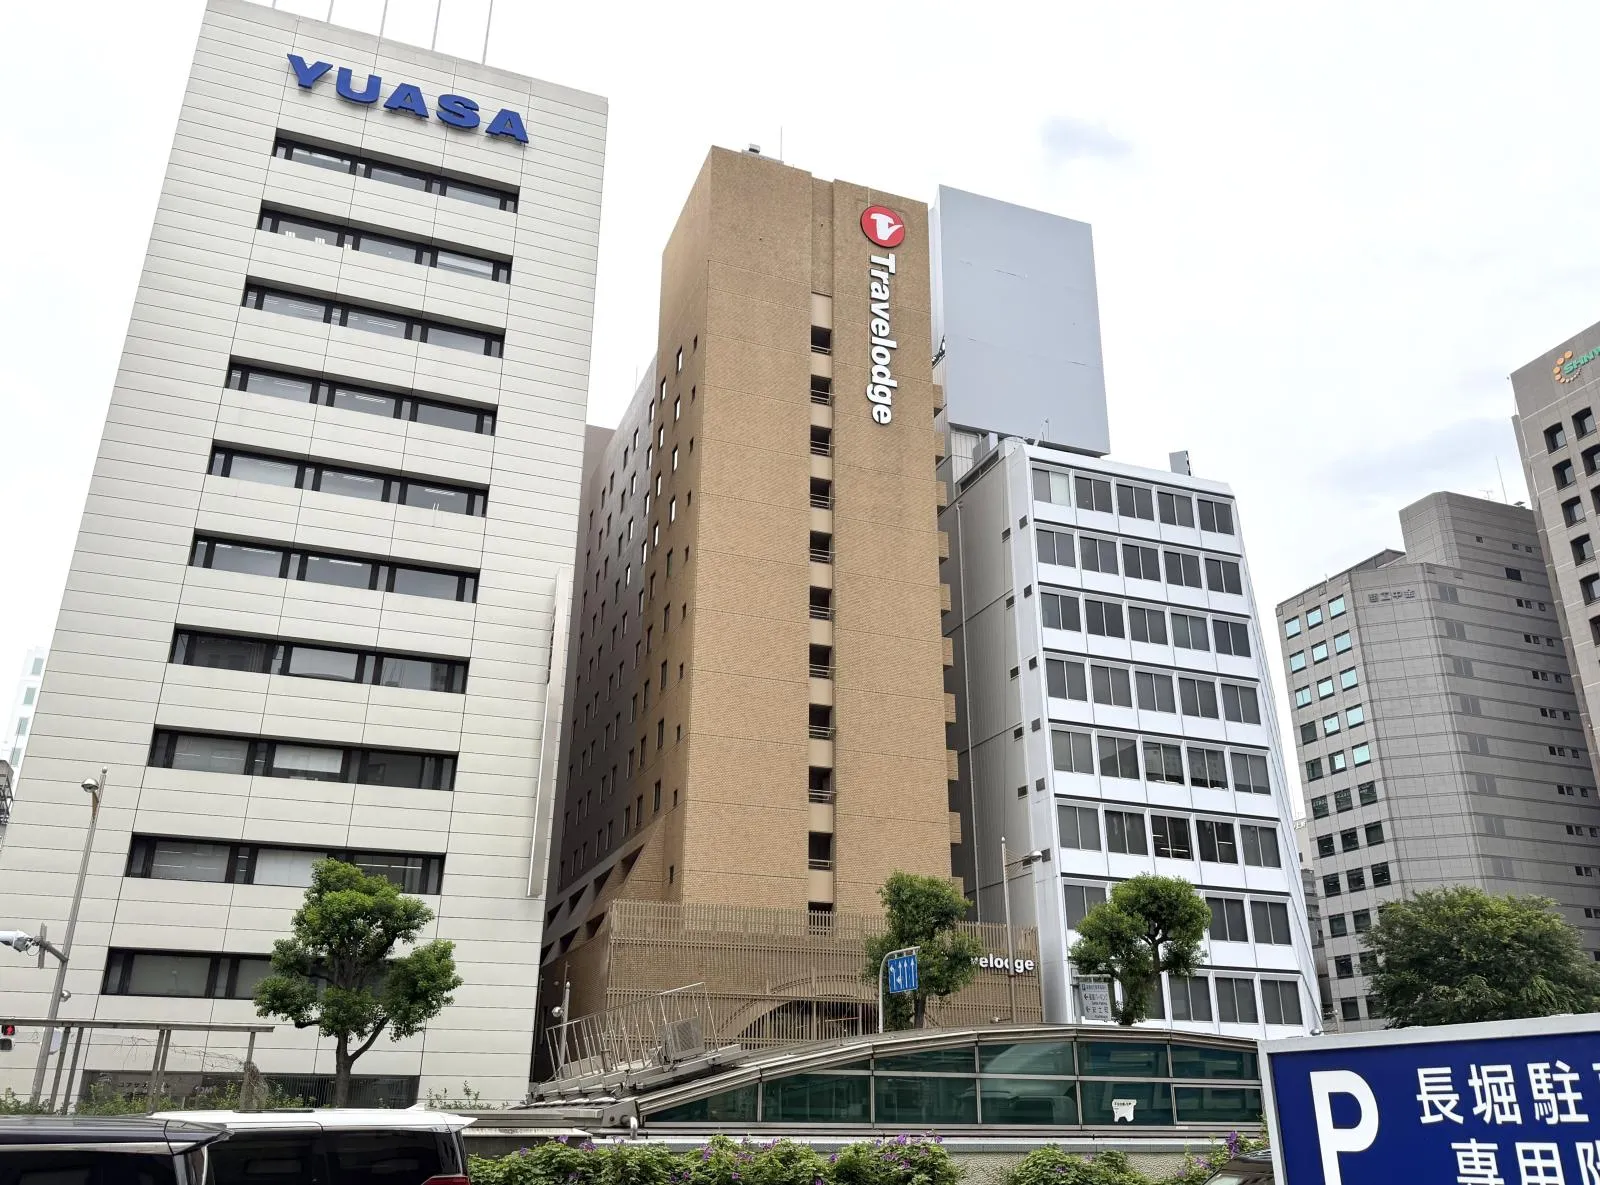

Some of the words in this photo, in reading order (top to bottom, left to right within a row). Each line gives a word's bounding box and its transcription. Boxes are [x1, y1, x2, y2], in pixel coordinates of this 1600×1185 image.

[287, 54, 529, 143] YUASA
[866, 253, 898, 425] Travelodge
[1310, 1070, 1379, 1185] P
[1416, 1060, 1600, 1125] 長堀駐
